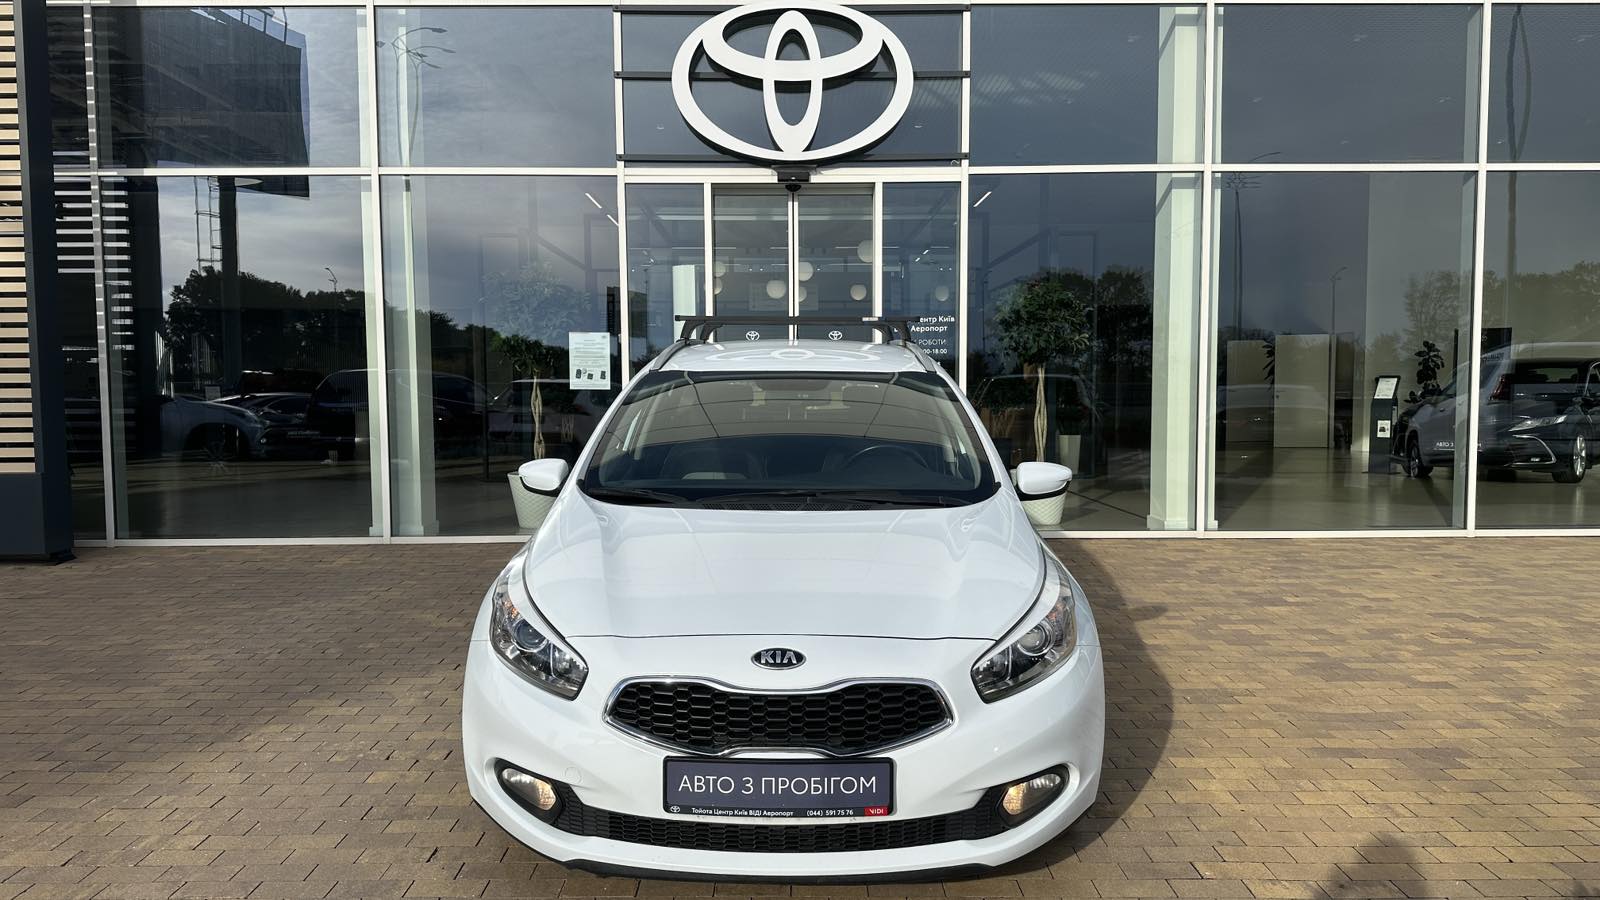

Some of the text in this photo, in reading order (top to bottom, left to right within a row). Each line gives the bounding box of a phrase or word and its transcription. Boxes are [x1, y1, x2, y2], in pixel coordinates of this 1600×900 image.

[918, 338, 946, 346] РОБОТИ
[760, 650, 797, 664] KIA
[678, 775, 876, 795] АВТО З ПРОБІГОМ
